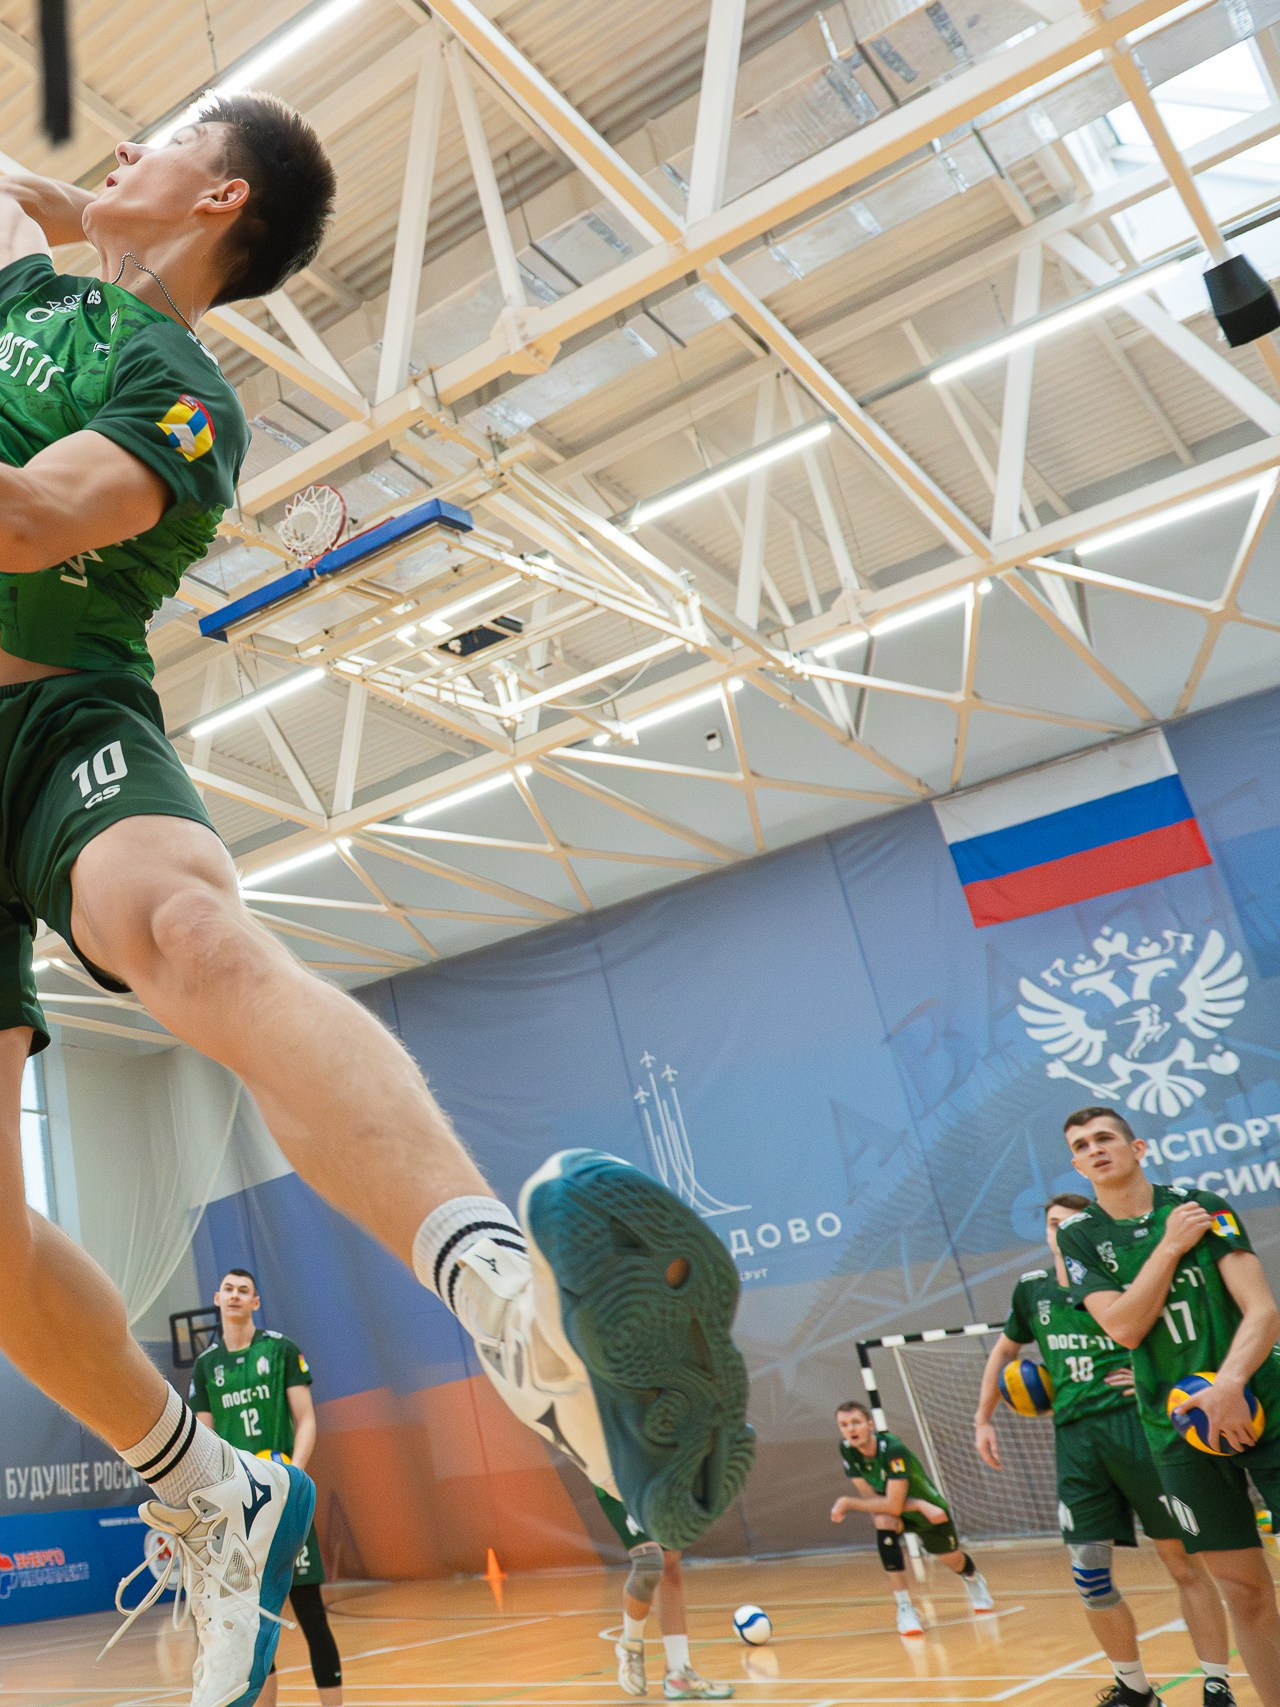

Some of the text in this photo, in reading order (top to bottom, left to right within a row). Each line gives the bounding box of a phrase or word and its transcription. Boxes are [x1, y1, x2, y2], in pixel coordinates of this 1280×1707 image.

[87, 290, 102, 305] GS
[71, 740, 128, 798] 10
[84, 784, 121, 810] GS
[1140, 1113, 1280, 1169] НСПОРТ
[729, 1212, 842, 1259] ДОВО
[1164, 1300, 1196, 1344] 17
[222, 1384, 271, 1409] МОСТ-11
[240, 1407, 263, 1437] 12
[6, 1461, 91, 1502] БУДУЩЕЕ
